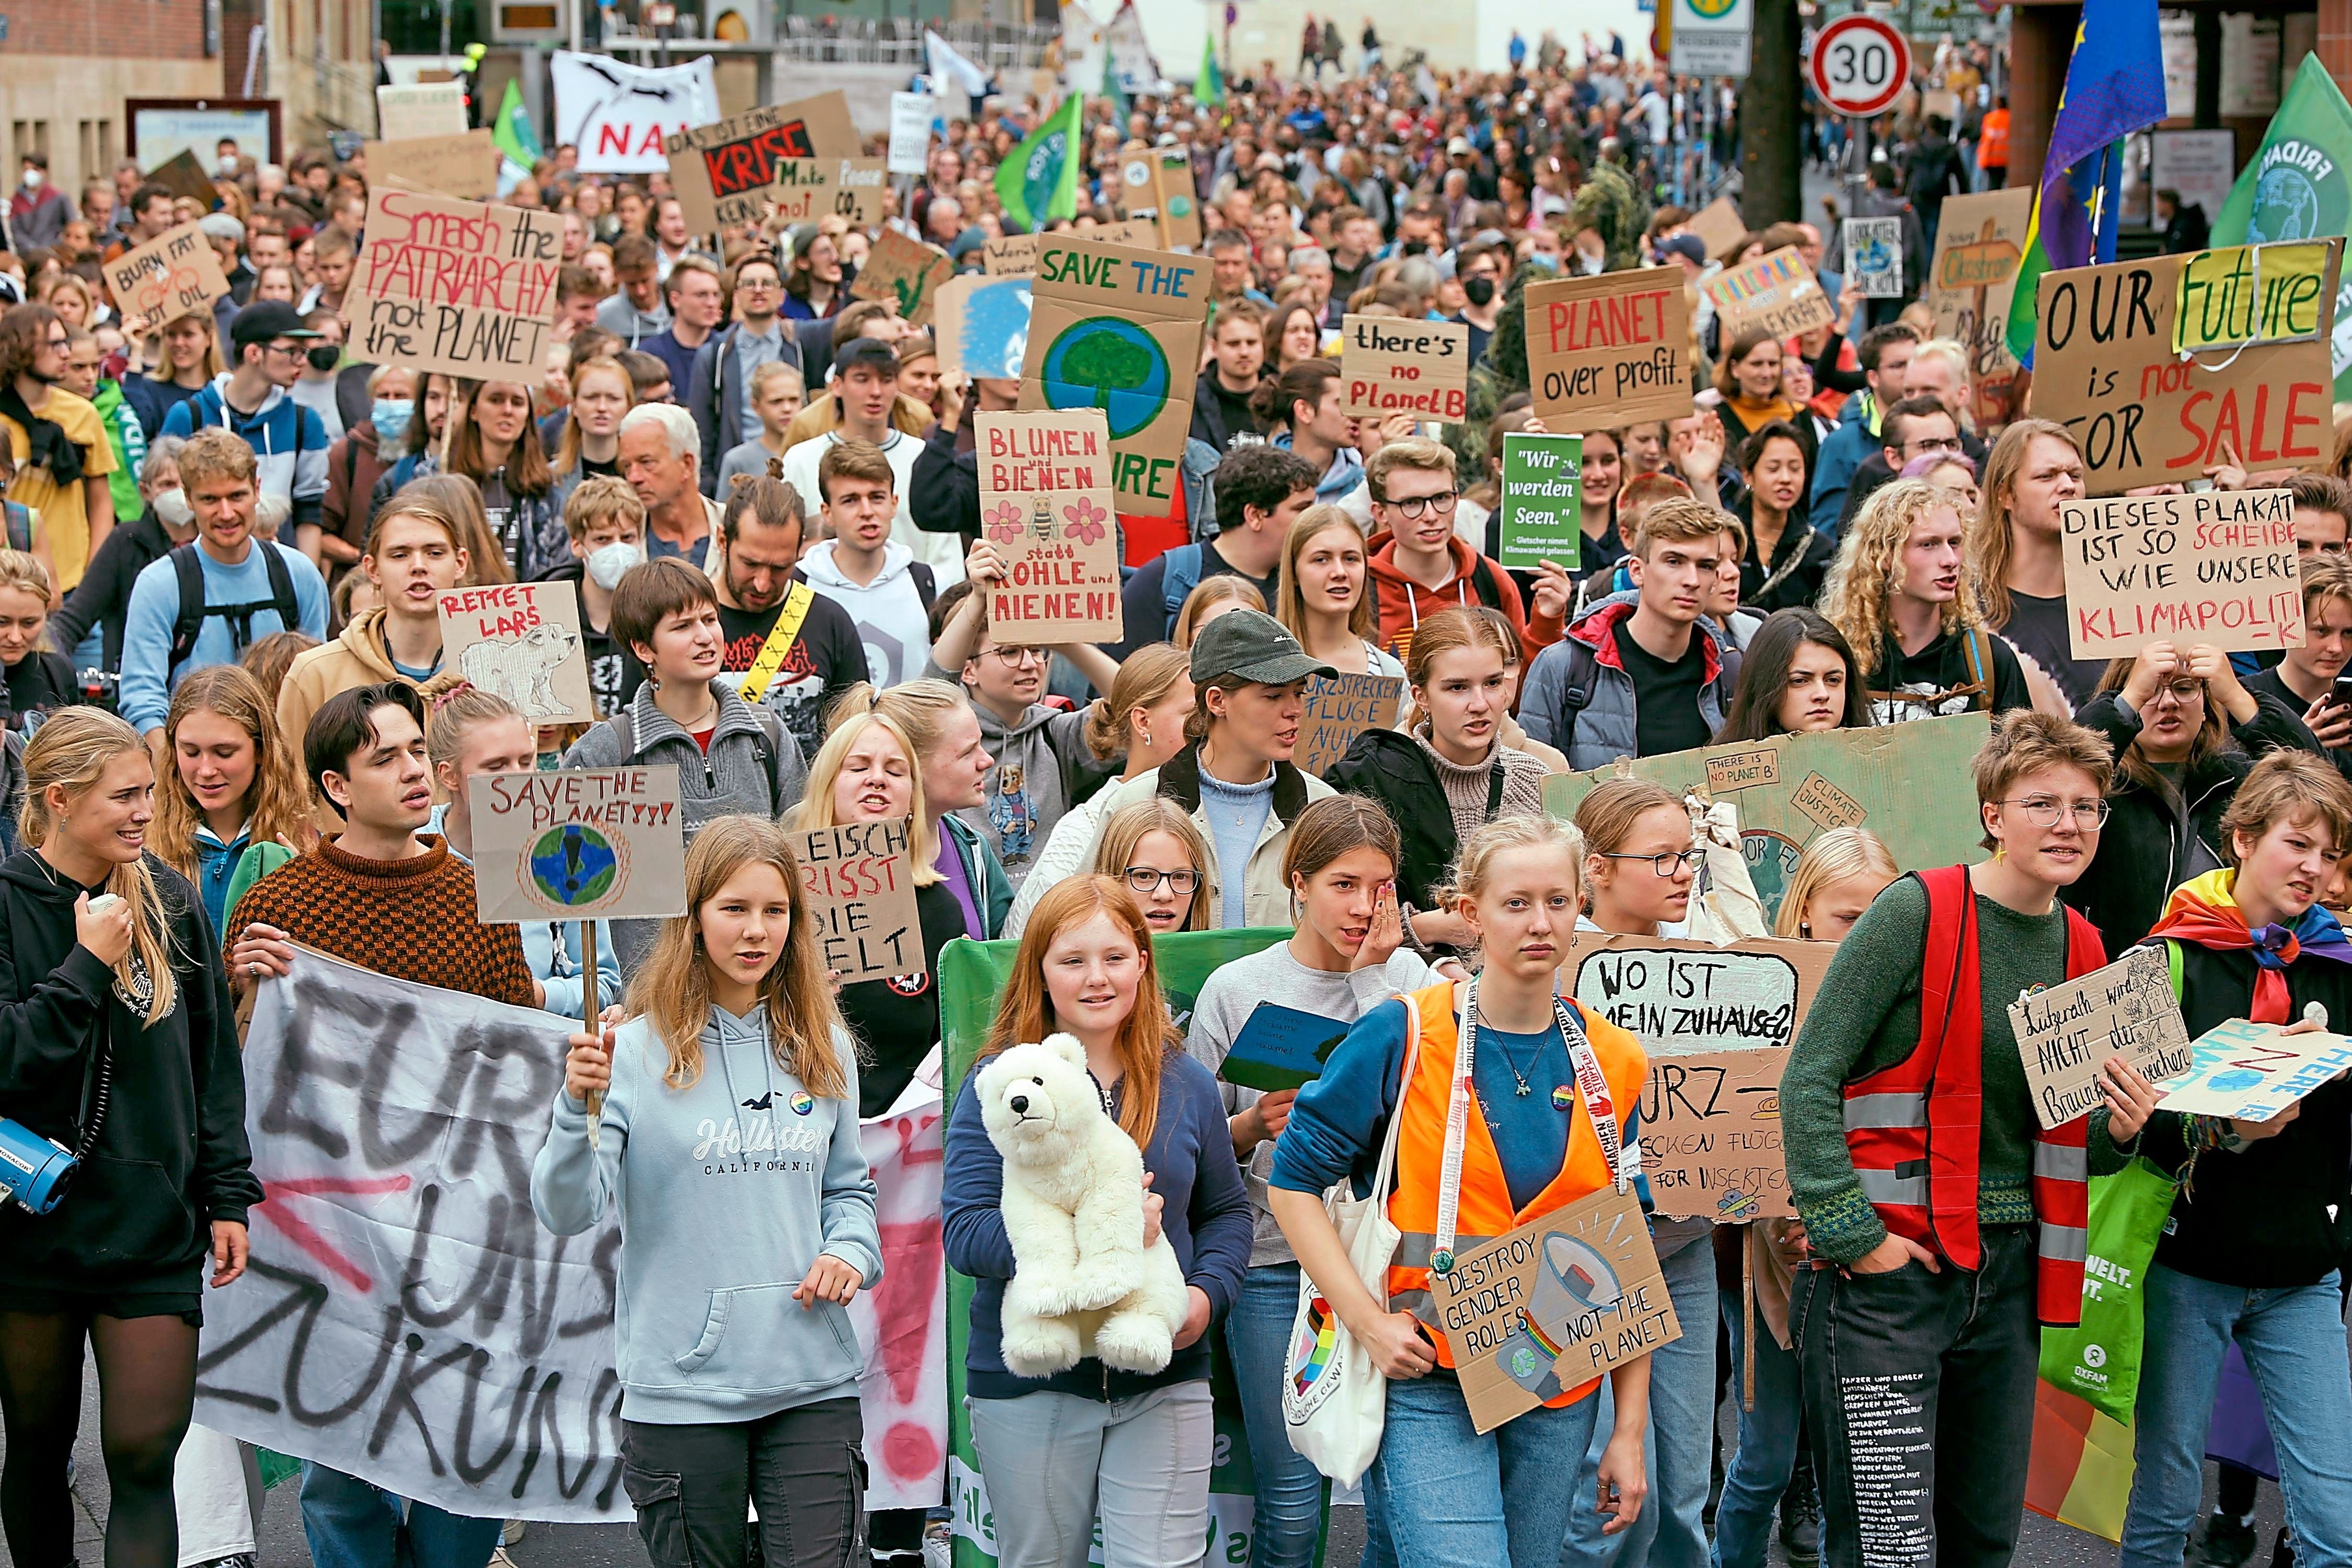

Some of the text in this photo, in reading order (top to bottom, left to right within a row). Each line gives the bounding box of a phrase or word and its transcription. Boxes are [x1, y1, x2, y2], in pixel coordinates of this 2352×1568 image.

[1834, 45, 1886, 84] 30
[668, 129, 707, 153] DAS
[704, 120, 805, 198] KRISE
[378, 193, 557, 259] Smash the
[116, 233, 196, 292] BURN FAT
[367, 241, 558, 316] PATRIARCHY
[1042, 249, 1122, 289] SAVE
[1131, 260, 1195, 298] THE
[179, 284, 210, 307] OIL
[2047, 249, 2321, 351] OUR Future
[370, 299, 425, 329] not
[1550, 291, 1671, 352] PLANET
[365, 305, 550, 365] the PLANET
[1354, 323, 1456, 355] there's
[1391, 365, 1421, 379] no
[1544, 347, 1684, 400] over profit.
[2089, 356, 2198, 399] is not
[989, 428, 1097, 457] BLUMEN
[2166, 382, 2323, 468] SALE
[993, 464, 1093, 491] BIENEN
[1029, 457, 1051, 468] und
[1509, 479, 1573, 498] werden
[2063, 493, 2292, 534] DIESES PLAKAT
[1027, 544, 1074, 560] statt
[2082, 528, 2176, 564] IST SO
[1091, 573, 1113, 584] und
[2100, 552, 2296, 592] WIE UNSERE
[440, 585, 536, 619] RETTET
[995, 592, 1115, 622] MIENEN!
[479, 606, 541, 638] LARS
[1305, 696, 1380, 722] FLÜGE
[1309, 724, 1359, 751] NUR
[1709, 755, 1761, 770] THERE IS
[1711, 767, 1759, 782] NO PLANET
[490, 771, 648, 813] SAVE THE
[1813, 779, 1861, 821] CLIMATE
[798, 823, 908, 862] EISCH
[1741, 838, 1767, 861] OR
[800, 856, 899, 899] RISST
[824, 926, 908, 974] ELT
[1599, 956, 1727, 1000] WO IST
[126, 1001, 138, 1013] DIE
[2022, 967, 2134, 1036] Lützerath wird
[1467, 984, 1477, 1071] BEIM KOHLEAUSSTIEG!
[1573, 1028, 1587, 1046] BEIM
[2037, 1014, 2137, 1075] NICHT der
[1575, 1064, 1594, 1097] KOHLE
[1579, 1050, 1606, 1093] STOPPEN!
[2235, 1103, 2277, 1121] IS
[693, 1116, 825, 1161] Hollister
[1654, 1170, 1690, 1187] FÜR
[1446, 1232, 1536, 1297] DESTROY
[1446, 1276, 1523, 1331] GENDER
[1566, 1286, 1654, 1346] NOT THE
[1465, 1306, 1528, 1356] ROLES
[1589, 1309, 1669, 1368] PLANET
[2071, 1377, 2108, 1392] Deutschland
[2074, 1366, 2108, 1383] OXFAM
[1844, 1392, 1883, 1402] MENSCHEN
[1844, 1401, 1881, 1410] GRENZEN
[1860, 1410, 1892, 1418] WAHREN
[1867, 1472, 1906, 1481] GEMEINSAM
